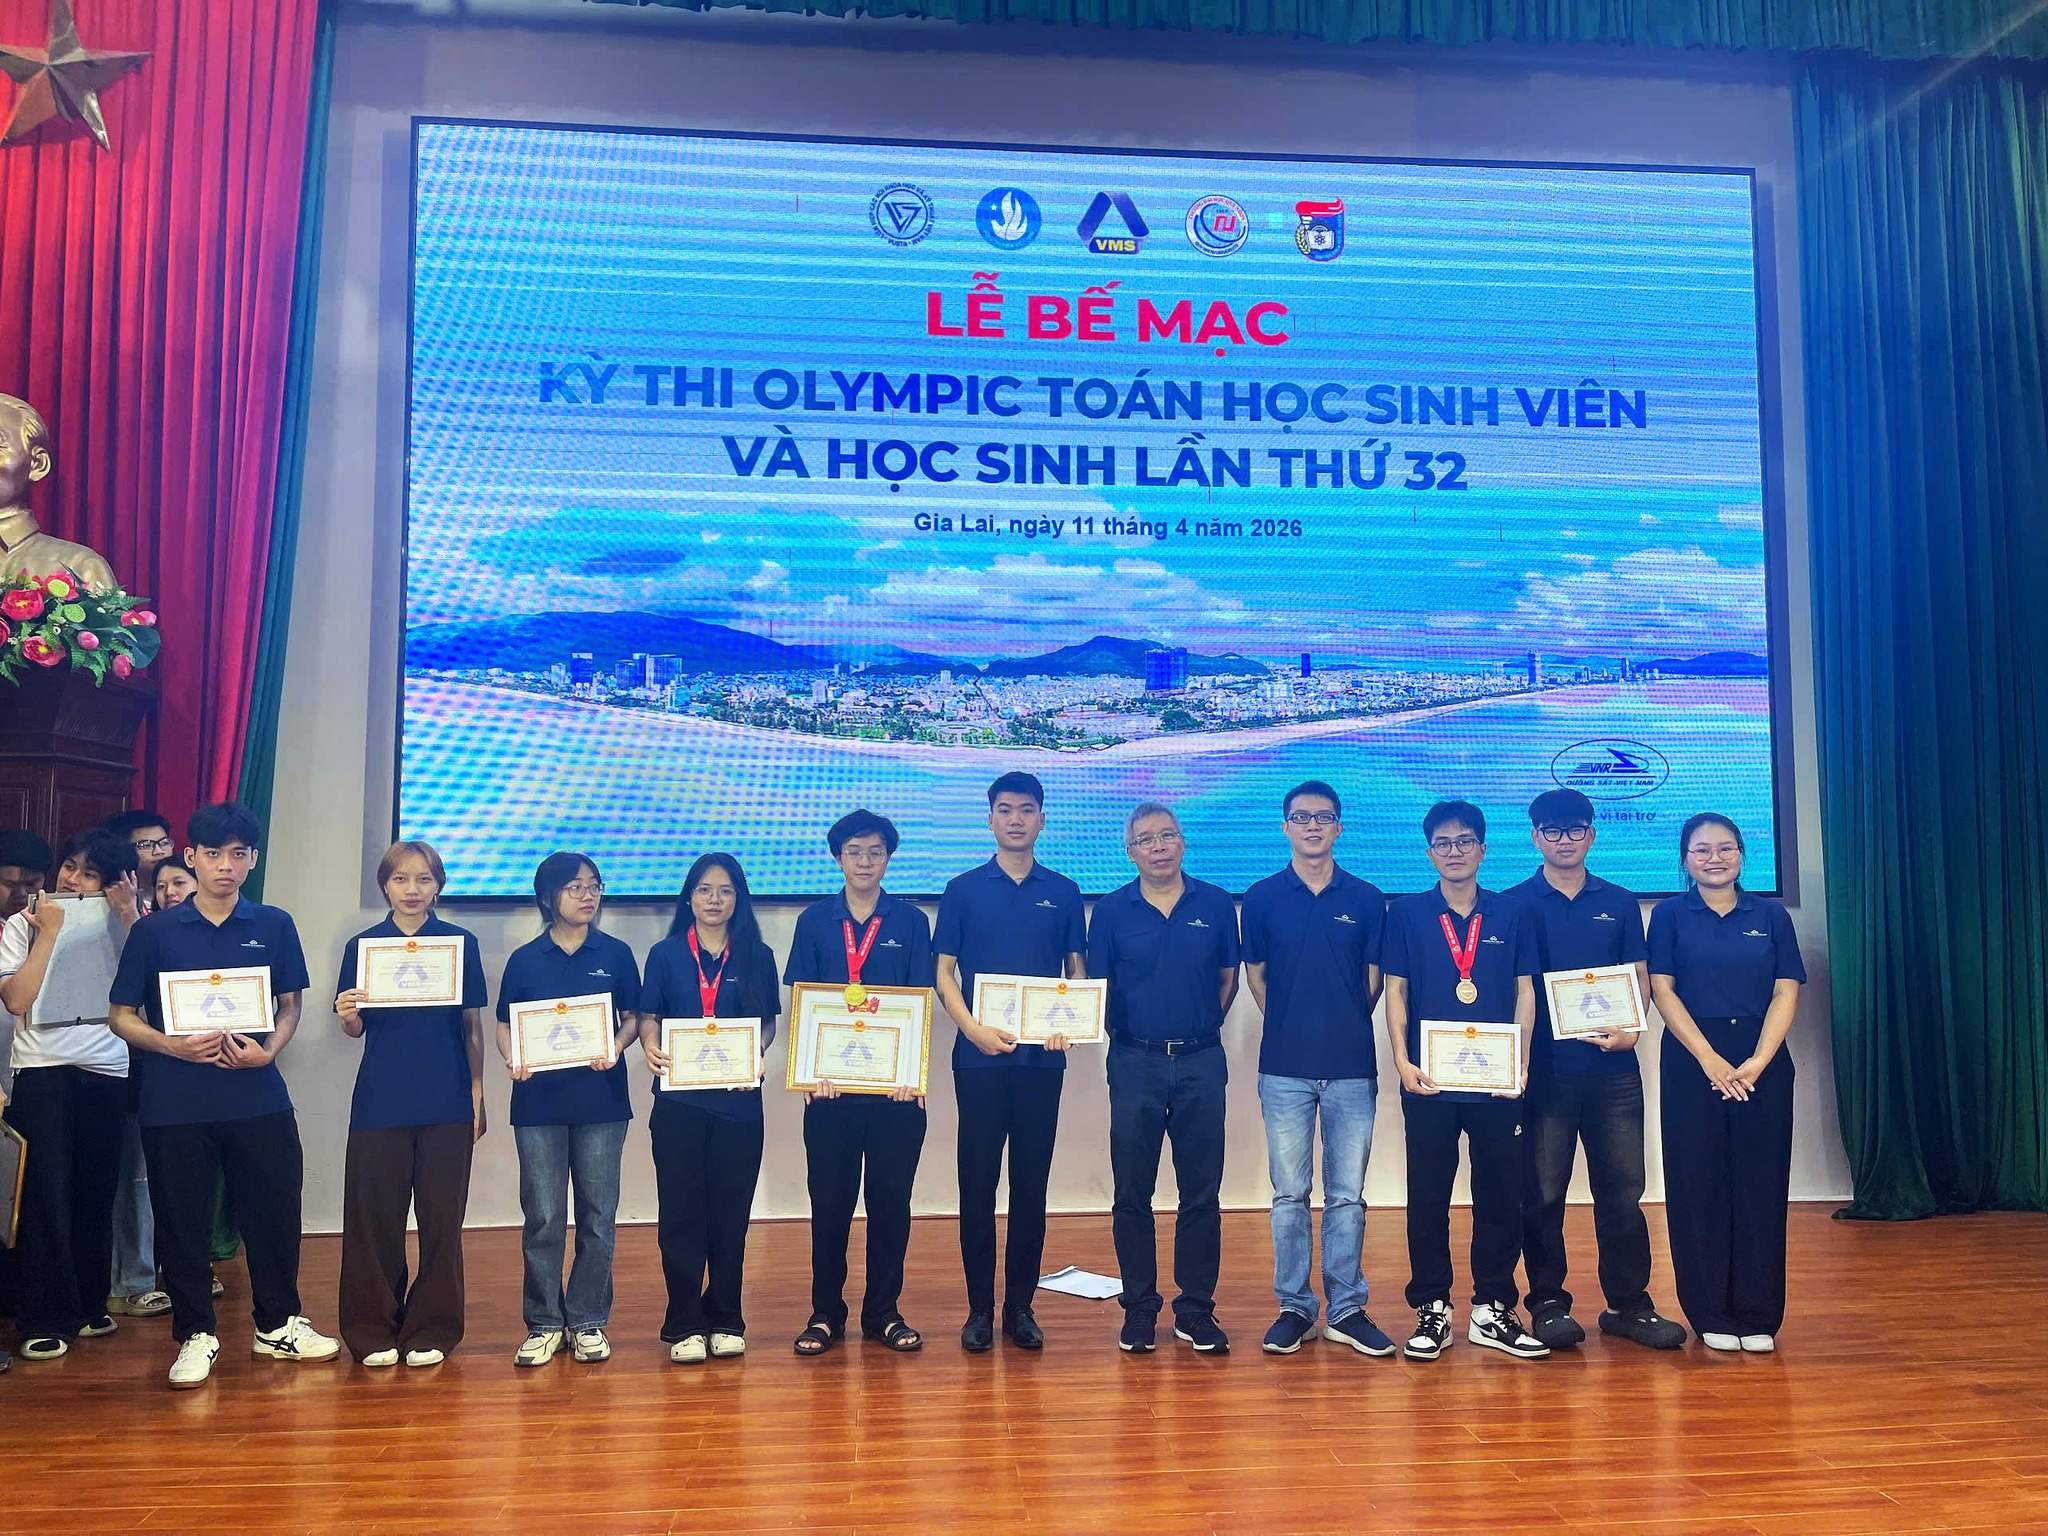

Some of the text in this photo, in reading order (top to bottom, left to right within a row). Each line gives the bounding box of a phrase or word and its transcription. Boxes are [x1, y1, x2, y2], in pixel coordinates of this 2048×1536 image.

[1095, 239, 1136, 252] VMS
[926, 271, 1290, 358] LỄ BẾ MẠC
[538, 351, 1648, 434] KỲ THI OLYMPIC TOÁN HỌC SINH VIÊN
[720, 424, 1468, 493] VÀ HỌC SINH LẦN THỨ 32
[914, 512, 1303, 541] Gia Lai, ngày 11 tháng 4 năm 2026
[1590, 763, 1612, 773] VNR
